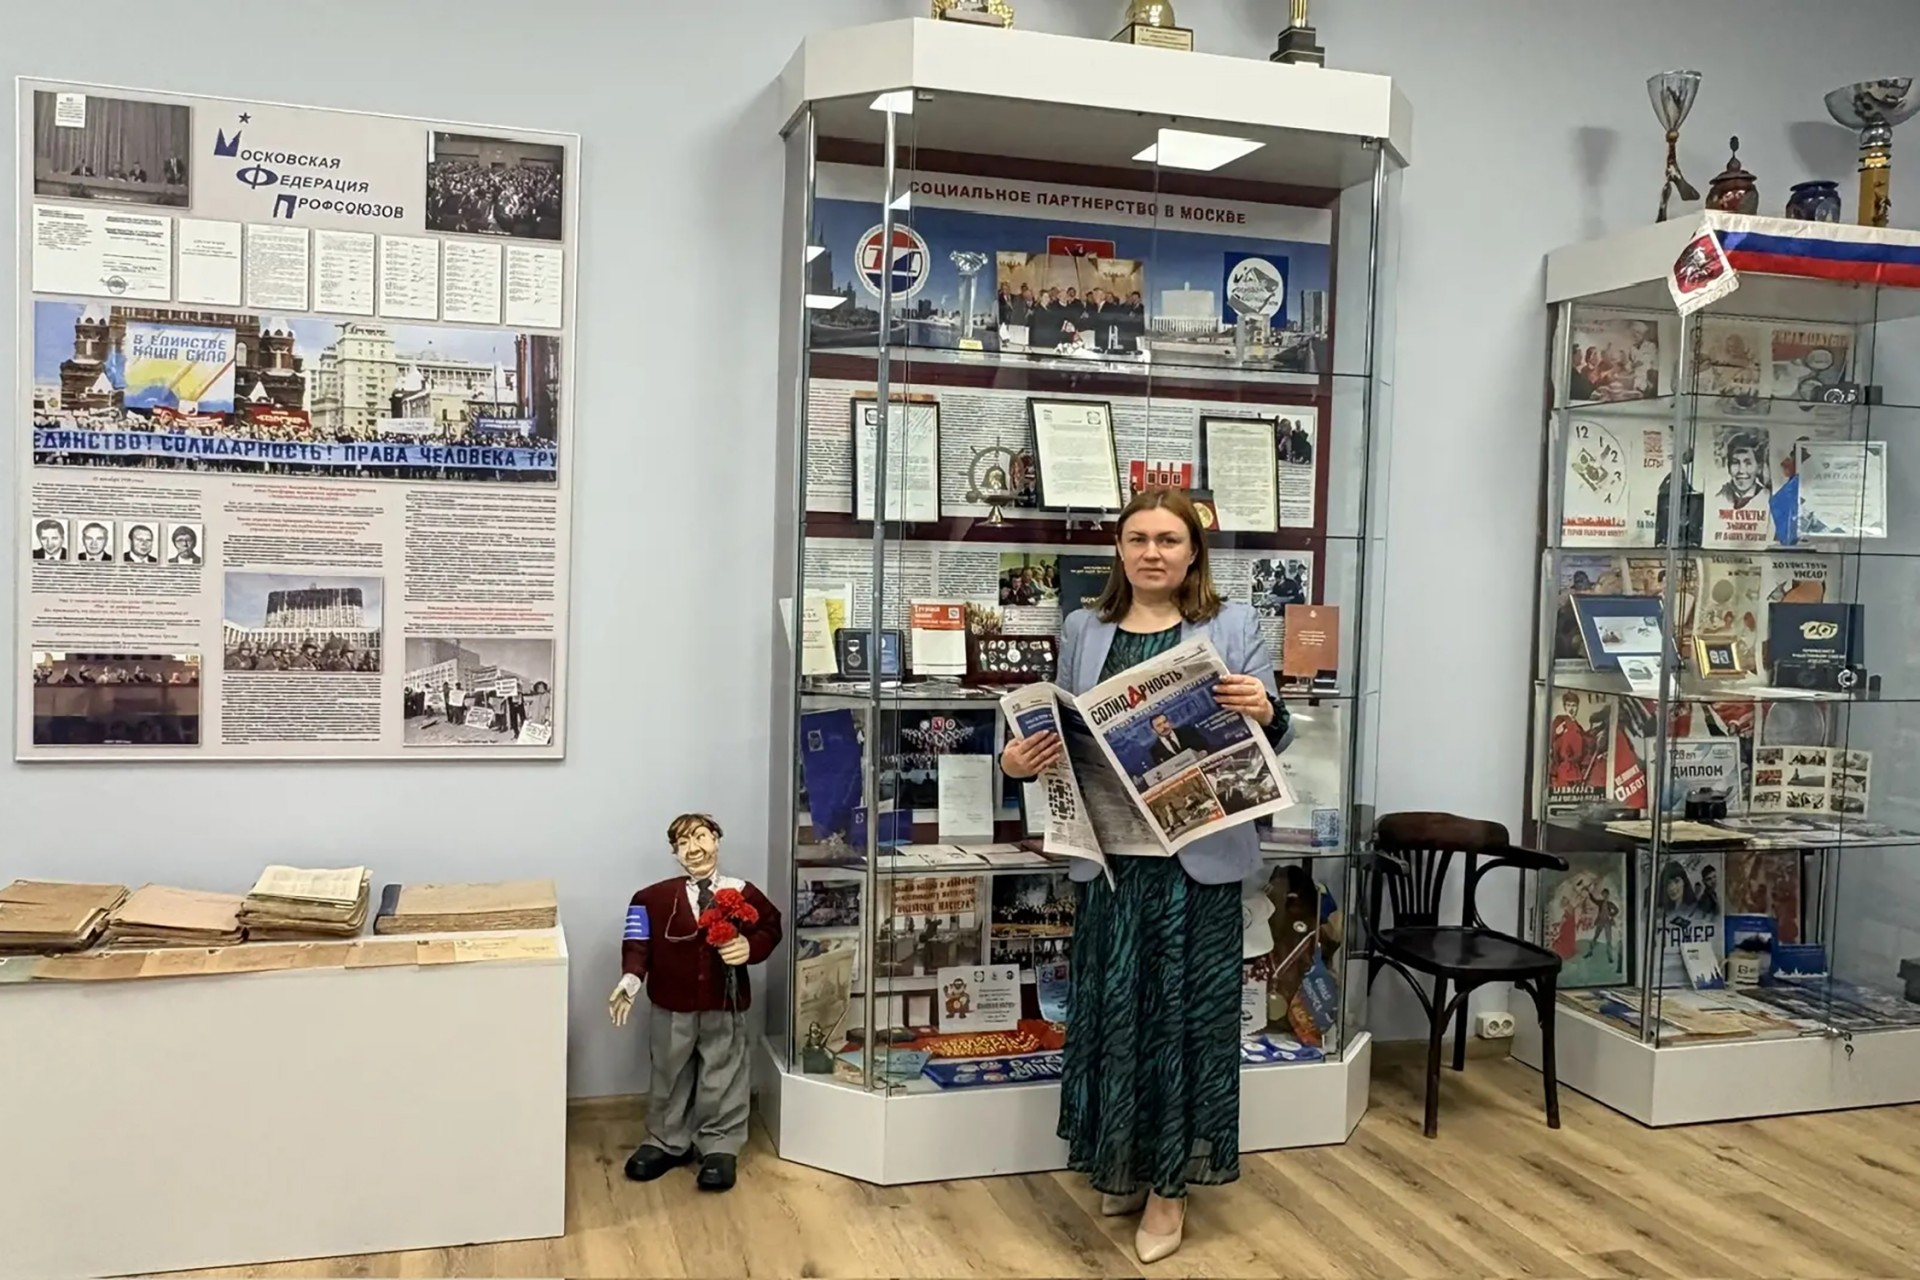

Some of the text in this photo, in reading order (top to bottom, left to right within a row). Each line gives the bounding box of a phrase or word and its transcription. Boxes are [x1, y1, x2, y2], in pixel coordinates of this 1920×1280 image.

[213, 127, 341, 169] МОСКОВСКАЯ
[236, 164, 369, 193] ФЕДЕРАЦИЯ
[273, 194, 404, 219] ПРОФСОЮЗОВ
[910, 180, 1246, 224] СОЦИАЛЬНОЕ ПАРТНЕРСТВО В МОСКВЕ
[133, 334, 227, 350] В ЕДИНСТВЕ
[133, 345, 227, 363] НАША СИЛА
[1576, 425, 1589, 438] 12
[344, 445, 408, 463] ПРАВА
[420, 448, 516, 466] ЧЕЛОВЕКА
[1610, 450, 1618, 463] 2
[1091, 669, 1183, 726] СОЛИДАРНОСТЬ
[1670, 764, 1724, 779] ДИПЛОМ
[1656, 925, 1715, 947] ТАЖЕР
